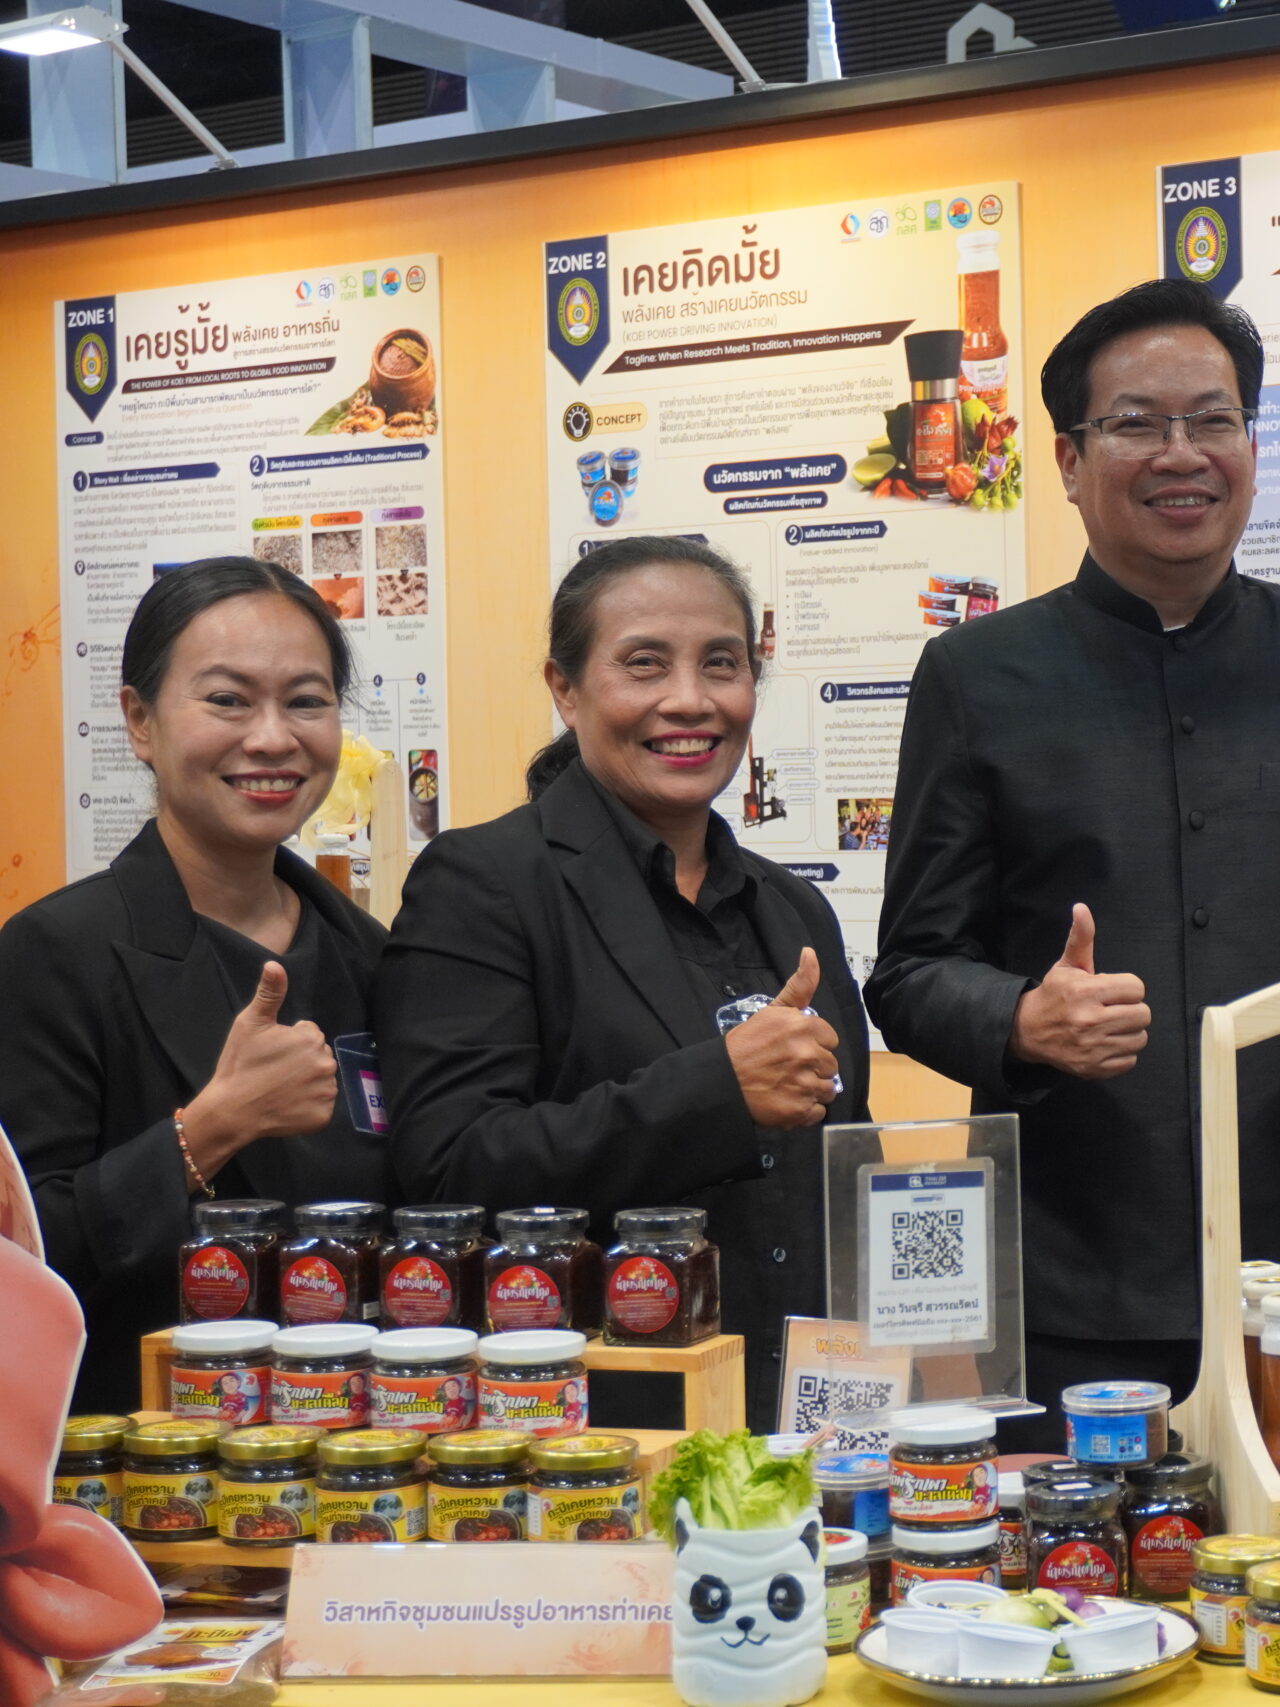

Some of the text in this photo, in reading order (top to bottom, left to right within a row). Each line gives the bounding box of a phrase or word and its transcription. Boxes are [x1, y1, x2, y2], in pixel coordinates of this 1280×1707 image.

[1164, 177, 1237, 203] ZONE 3
[548, 251, 606, 275] ZONE 2
[623, 224, 780, 297] เคยคิดมั้ย
[67, 308, 114, 327] ZONE 1
[622, 290, 808, 324] พลังเคย สร้างเคยนวัตกรรม
[126, 302, 228, 370] เคยรู้มั้ย
[232, 324, 278, 344] พลังเคย
[622, 314, 777, 345] (KOEI POWER DRIVING INNOVATION)
[624, 327, 882, 367] Tagline: When Research Meets Tradition, Innovation Happens
[131, 363, 326, 390] THE POWER OF FROM LOCAL ROOTS TO GLOBAL FOOD INNOVATION
[596, 412, 642, 427] CONCEPT
[72, 435, 97, 444] Concept
[252, 457, 259, 472] 2
[713, 462, 837, 485] นวัตกรรมจาก “พลังเคย”
[78, 476, 82, 488] 1
[789, 527, 798, 542] 2
[824, 685, 832, 700] 4
[877, 1306, 896, 1315] นาง
[324, 1596, 674, 1632] วิสาหกิจชุมชนแปรรูปอาหารท่าเคย
